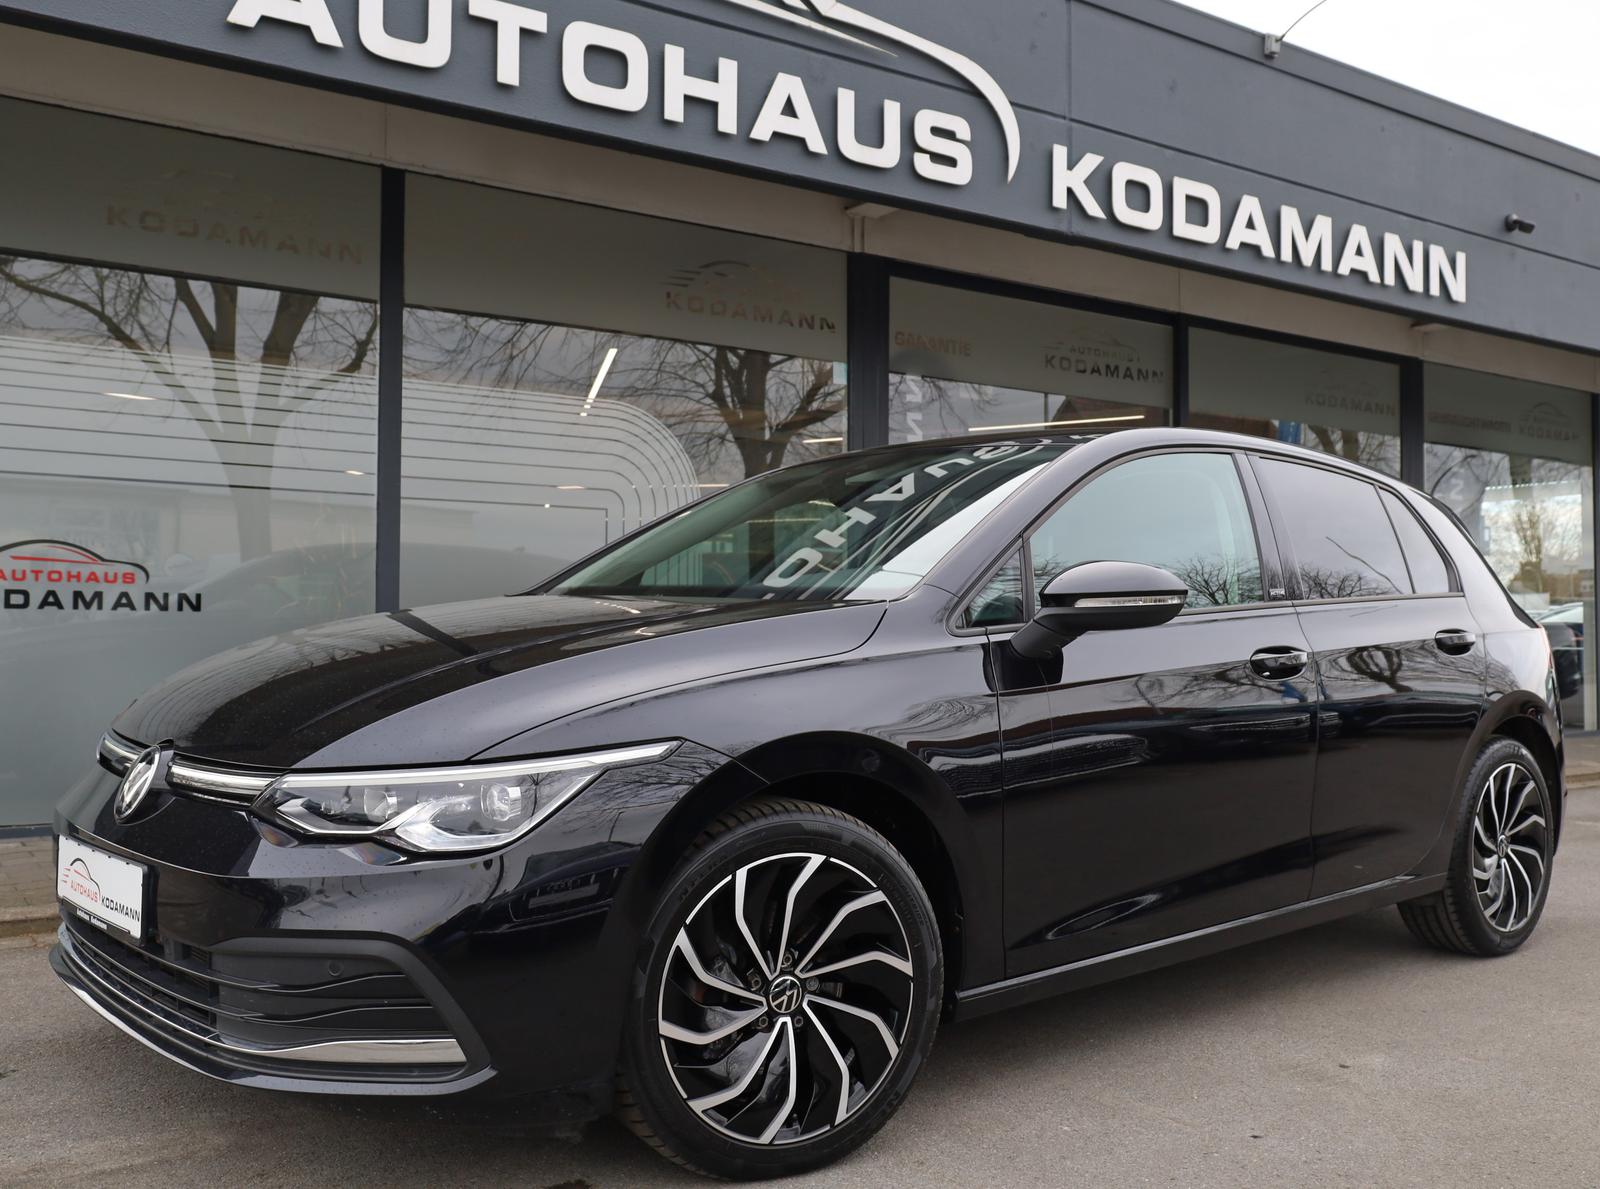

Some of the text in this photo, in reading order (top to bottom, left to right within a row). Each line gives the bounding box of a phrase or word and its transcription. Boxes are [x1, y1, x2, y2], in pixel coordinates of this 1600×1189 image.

[1052, 143, 1468, 304] KODAMANN
[1045, 352, 1165, 383] KODAMANN
[3, 588, 202, 612] DAMANN
[70, 880, 99, 903] AUTOHAUS
[101, 895, 141, 923] KODAMANN
